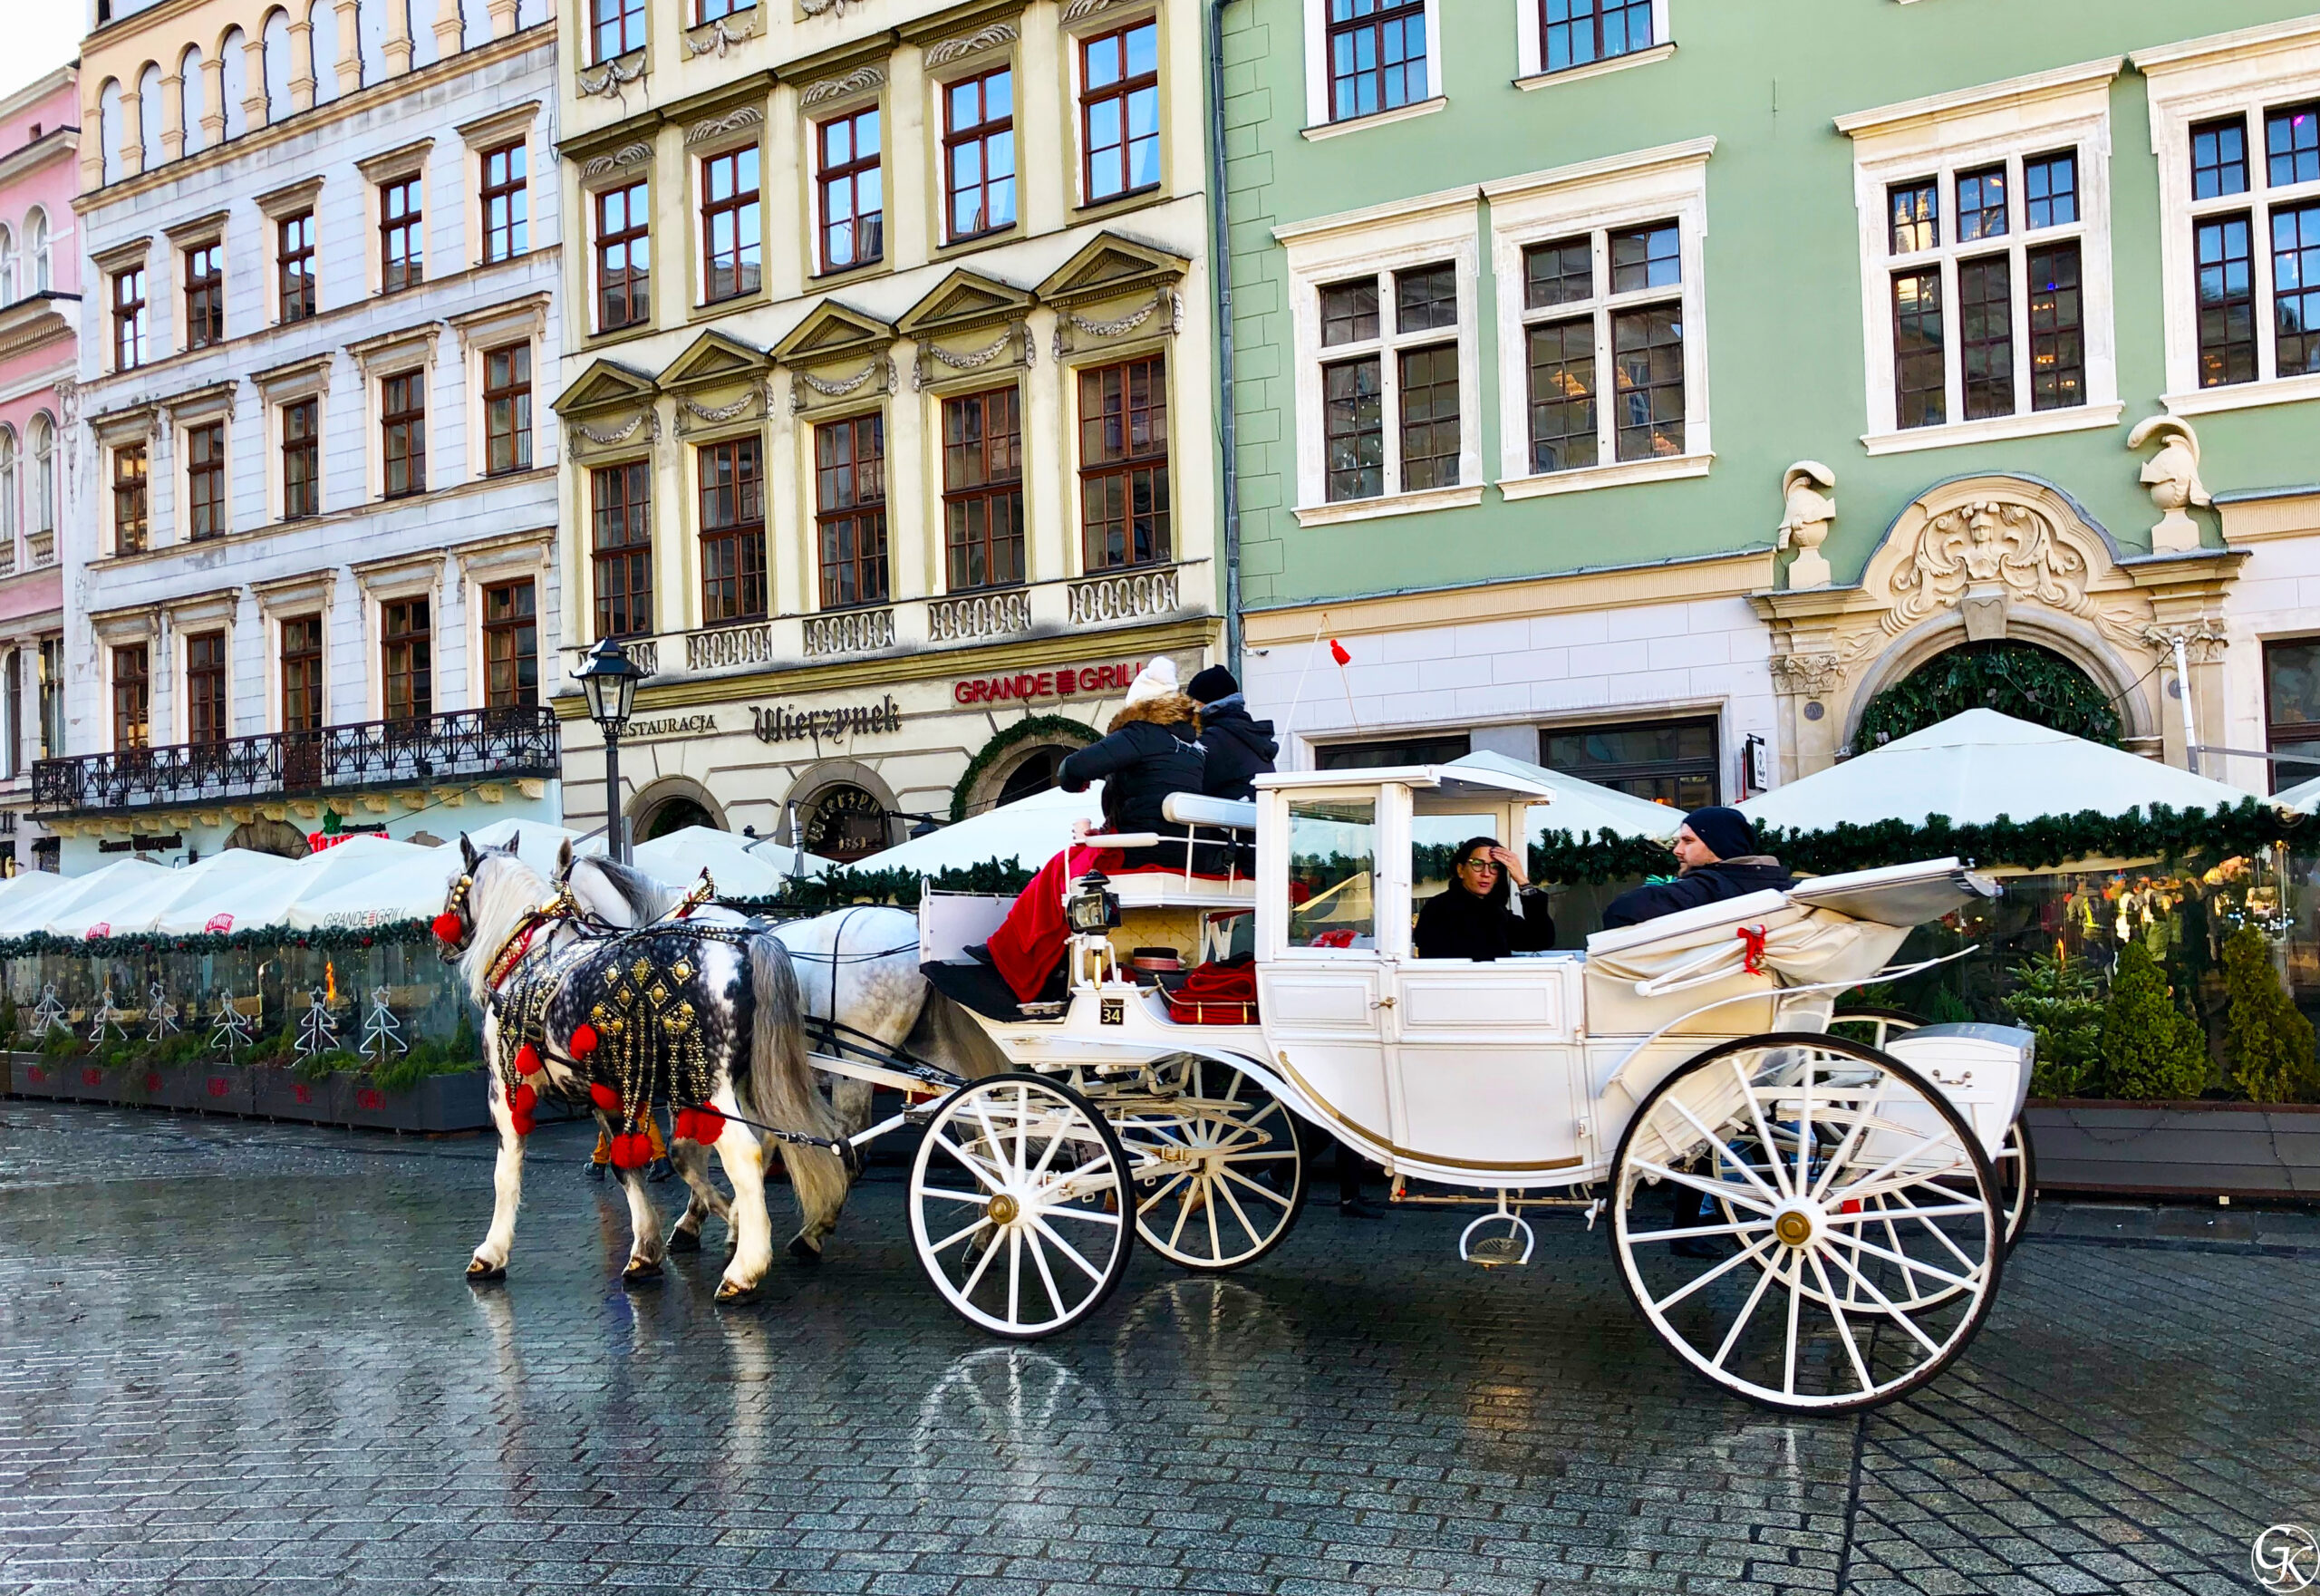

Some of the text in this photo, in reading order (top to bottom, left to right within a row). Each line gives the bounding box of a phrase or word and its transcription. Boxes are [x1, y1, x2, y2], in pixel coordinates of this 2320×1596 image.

[954, 672, 1054, 704] GRANDE
[749, 692, 903, 745] Wierzynek
[323, 910, 370, 927] GRANDE
[1102, 1008, 1122, 1023] 34
